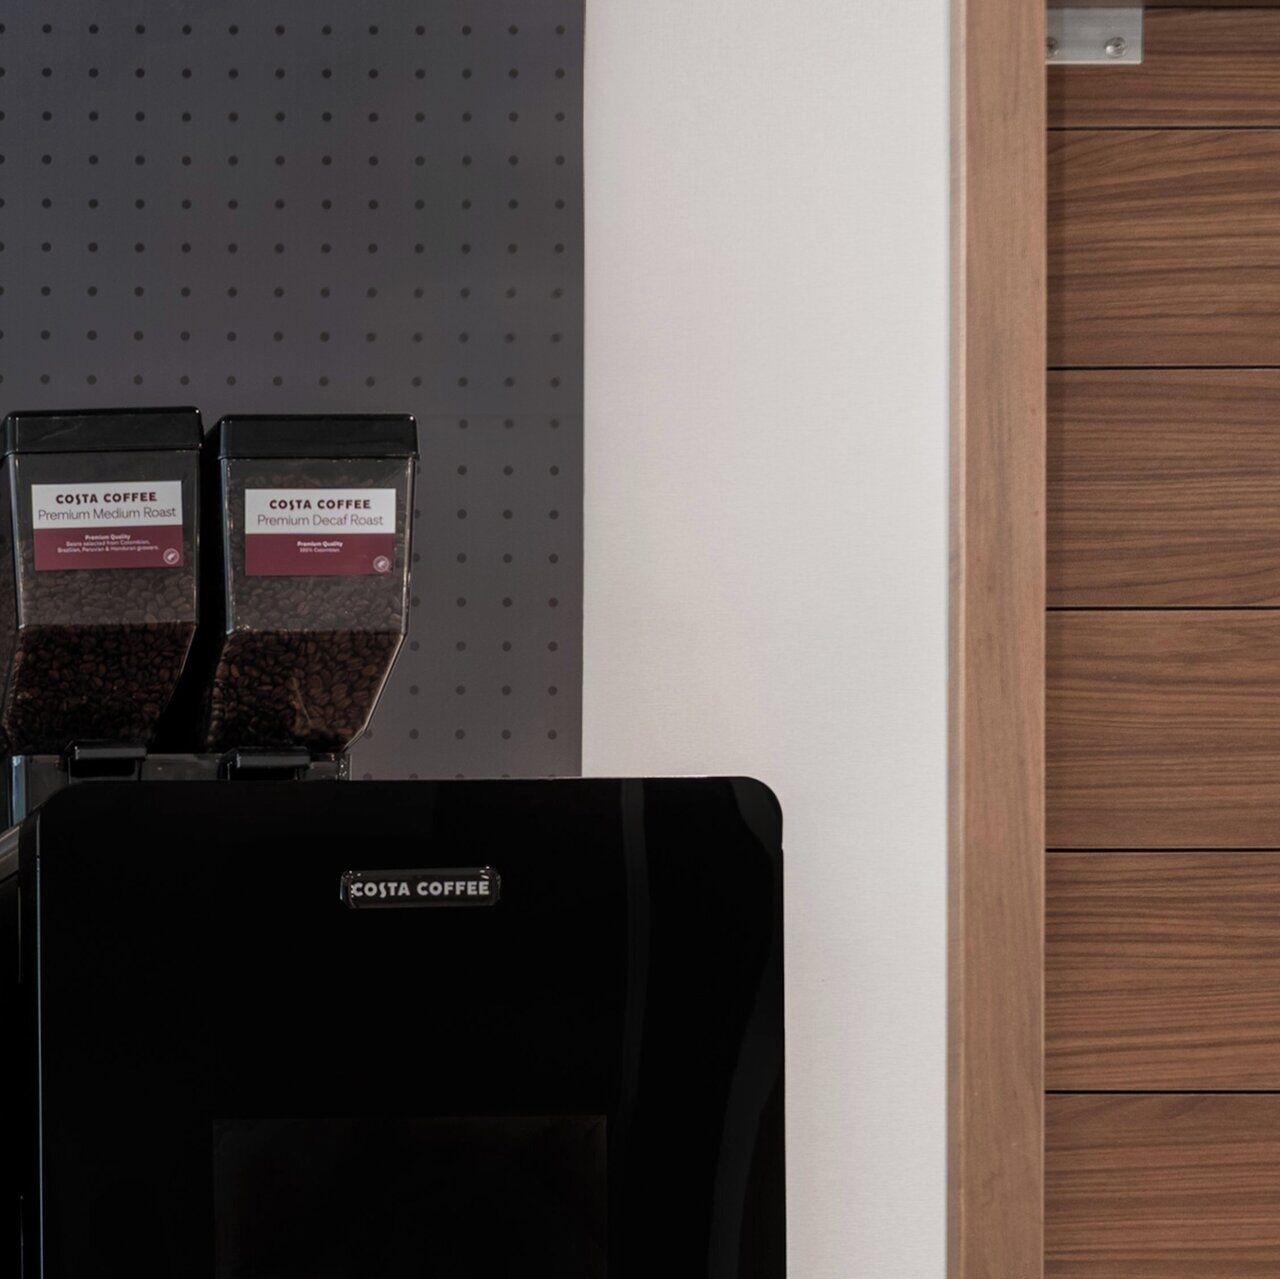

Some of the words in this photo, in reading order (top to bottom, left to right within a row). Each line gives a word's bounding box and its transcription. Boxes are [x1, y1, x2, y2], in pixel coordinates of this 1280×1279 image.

[56, 493, 98, 505] COSTA
[103, 492, 158, 503] COFFEE
[269, 499, 312, 511] COSTA
[317, 499, 371, 510] COFFEE
[38, 509, 90, 521] Premium
[93, 507, 140, 520] Medium
[143, 507, 176, 518] Roast
[257, 513, 309, 526] Premium
[313, 513, 348, 526] Decaf
[351, 513, 384, 526] Roast
[353, 882, 411, 898] COSTA
[416, 881, 490, 896] COFFEE
